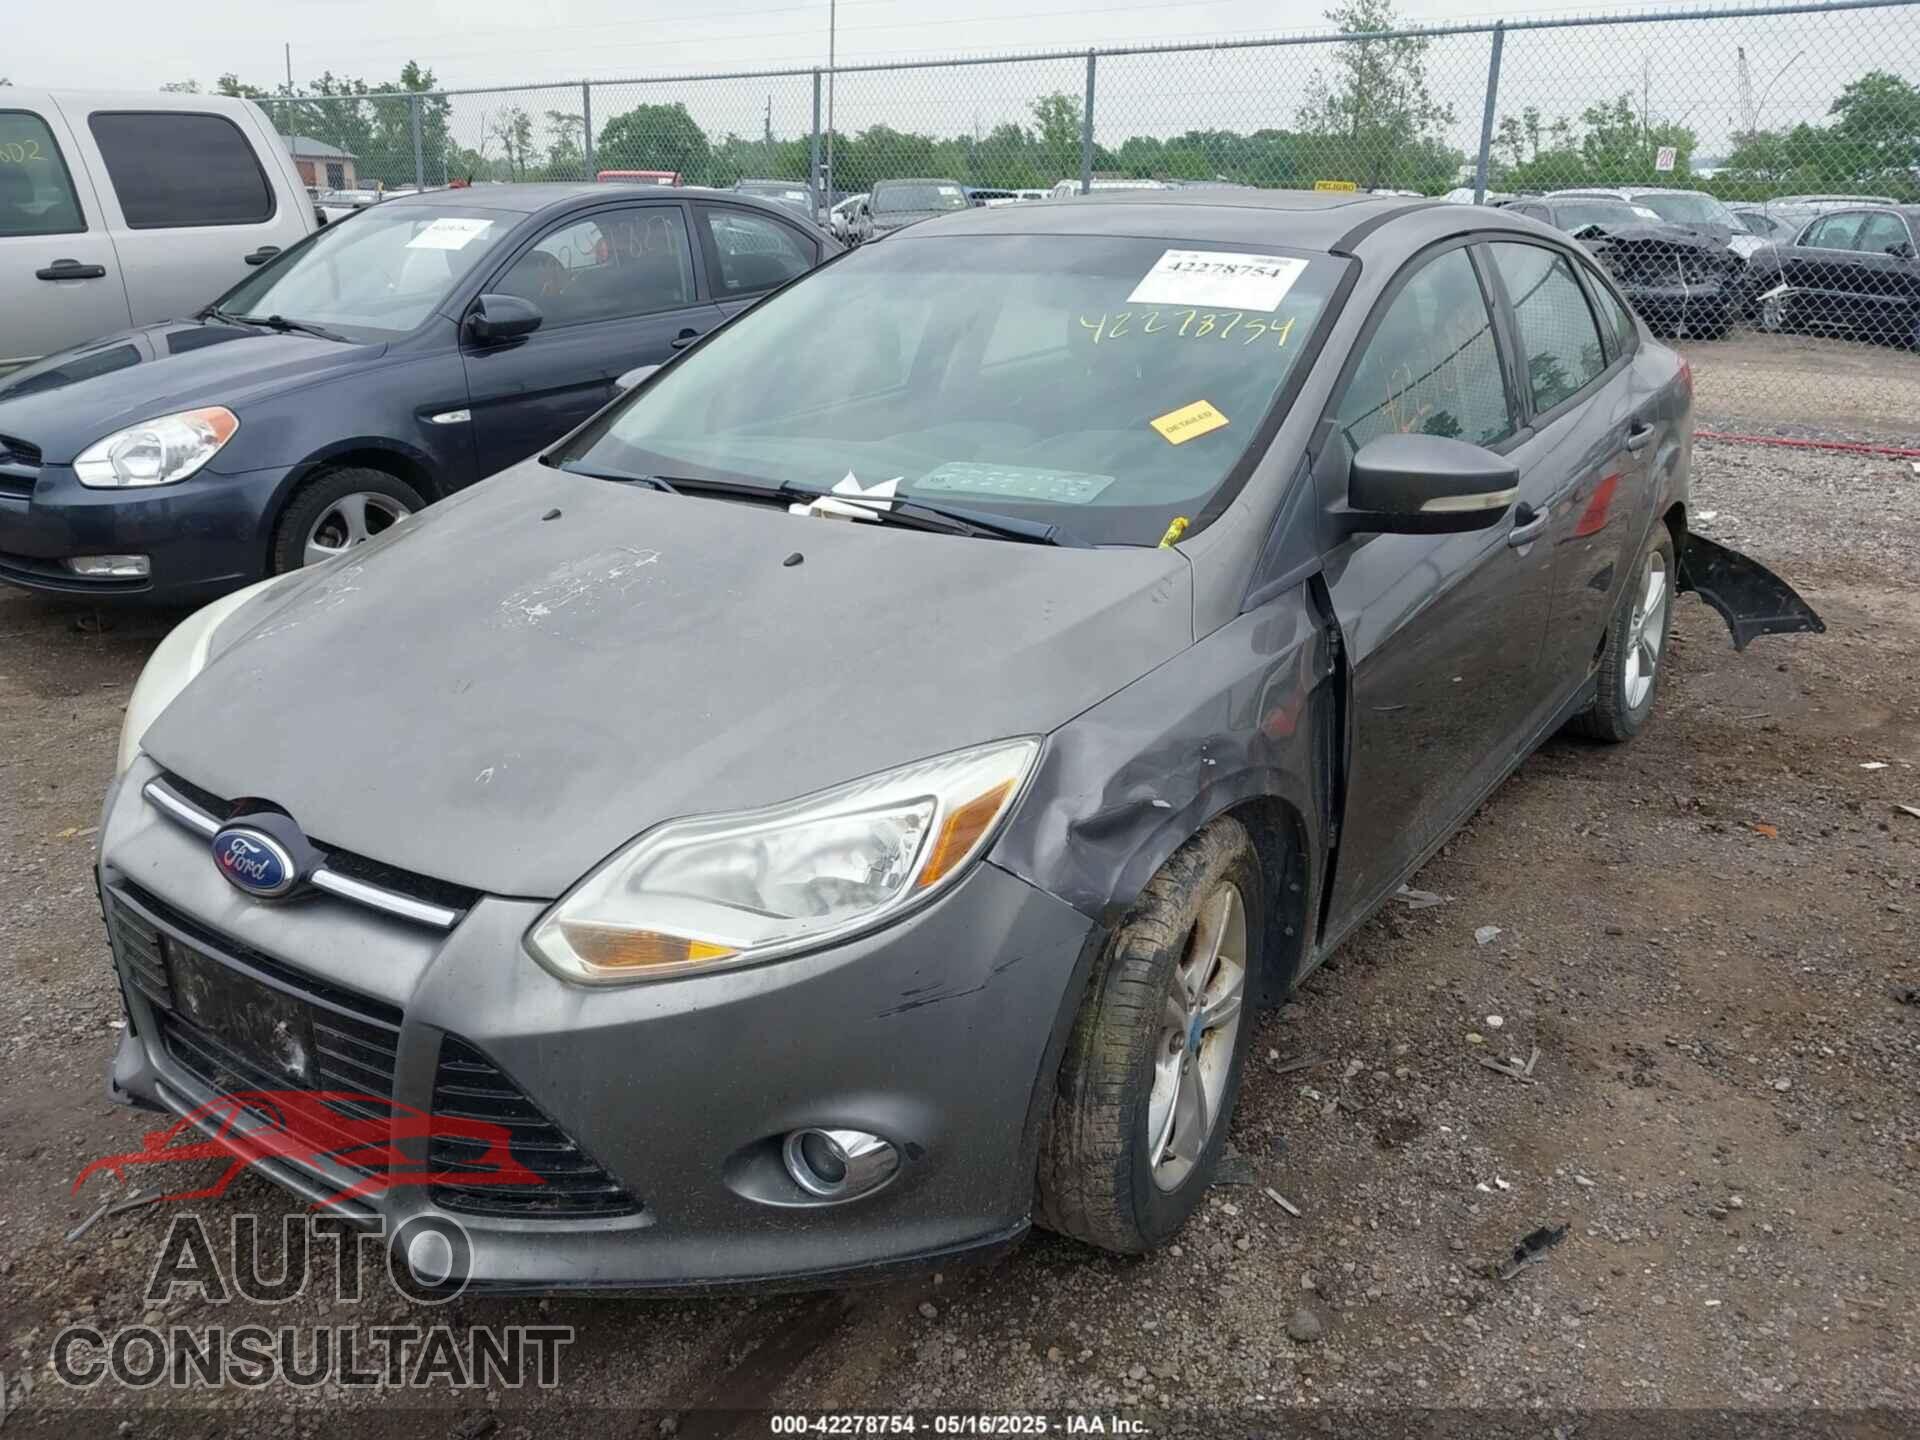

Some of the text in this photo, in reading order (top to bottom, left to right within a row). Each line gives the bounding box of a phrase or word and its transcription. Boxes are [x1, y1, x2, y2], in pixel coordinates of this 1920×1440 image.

[1316, 182, 1355, 192] PELIGRO
[1168, 261, 1281, 278] 42278754
[1079, 309, 1296, 347] 42278754
[1165, 411, 1212, 433] DETAILED
[223, 838, 270, 880] Ford
